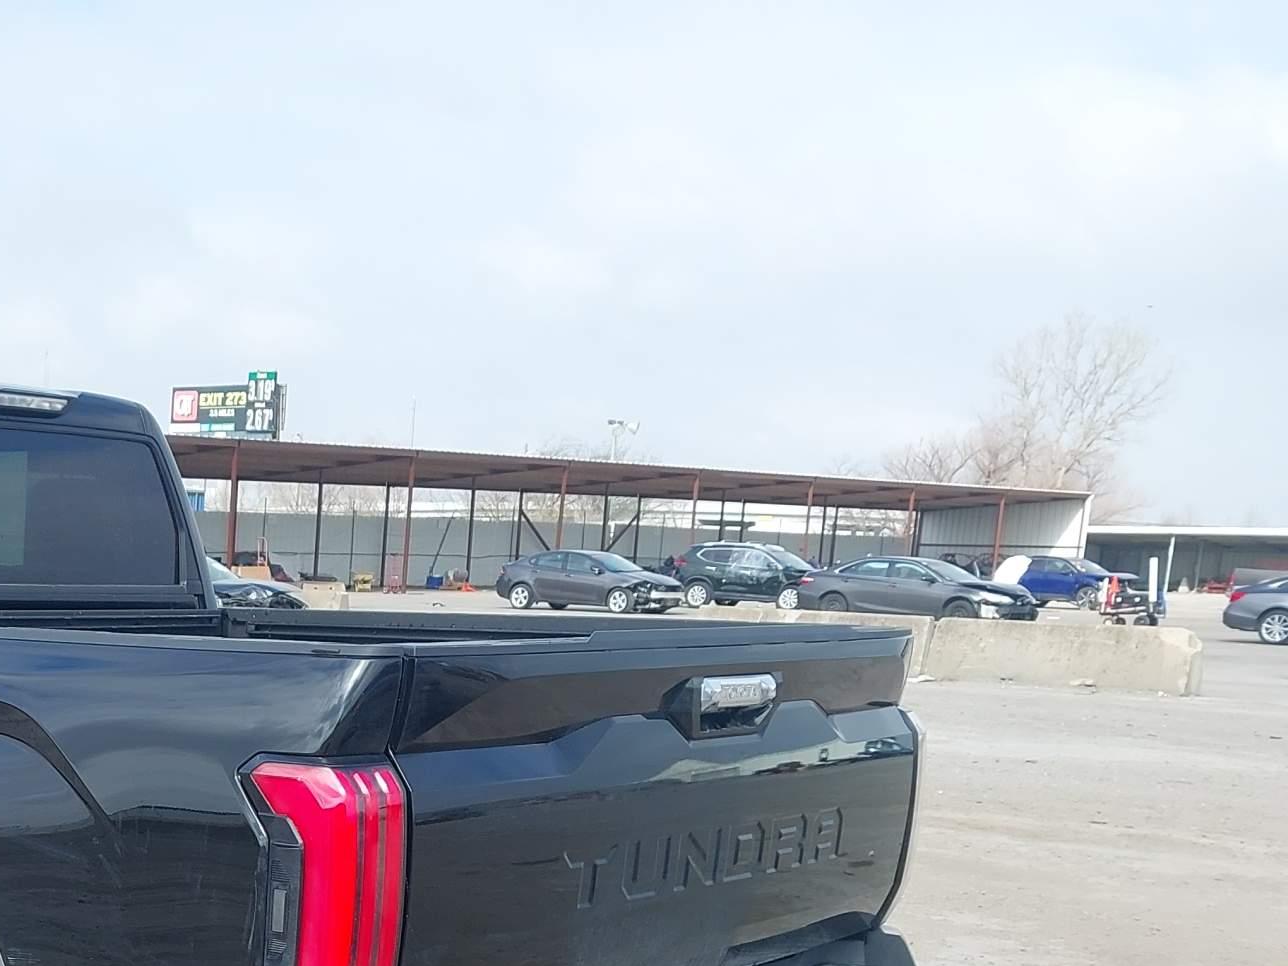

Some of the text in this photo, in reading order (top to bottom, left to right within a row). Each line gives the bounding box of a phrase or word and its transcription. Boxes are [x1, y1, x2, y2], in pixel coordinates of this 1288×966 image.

[177, 395, 195, 417] QT
[199, 393, 224, 407] EXIT
[225, 391, 247, 406] 273
[563, 806, 846, 909] TUNDRA
